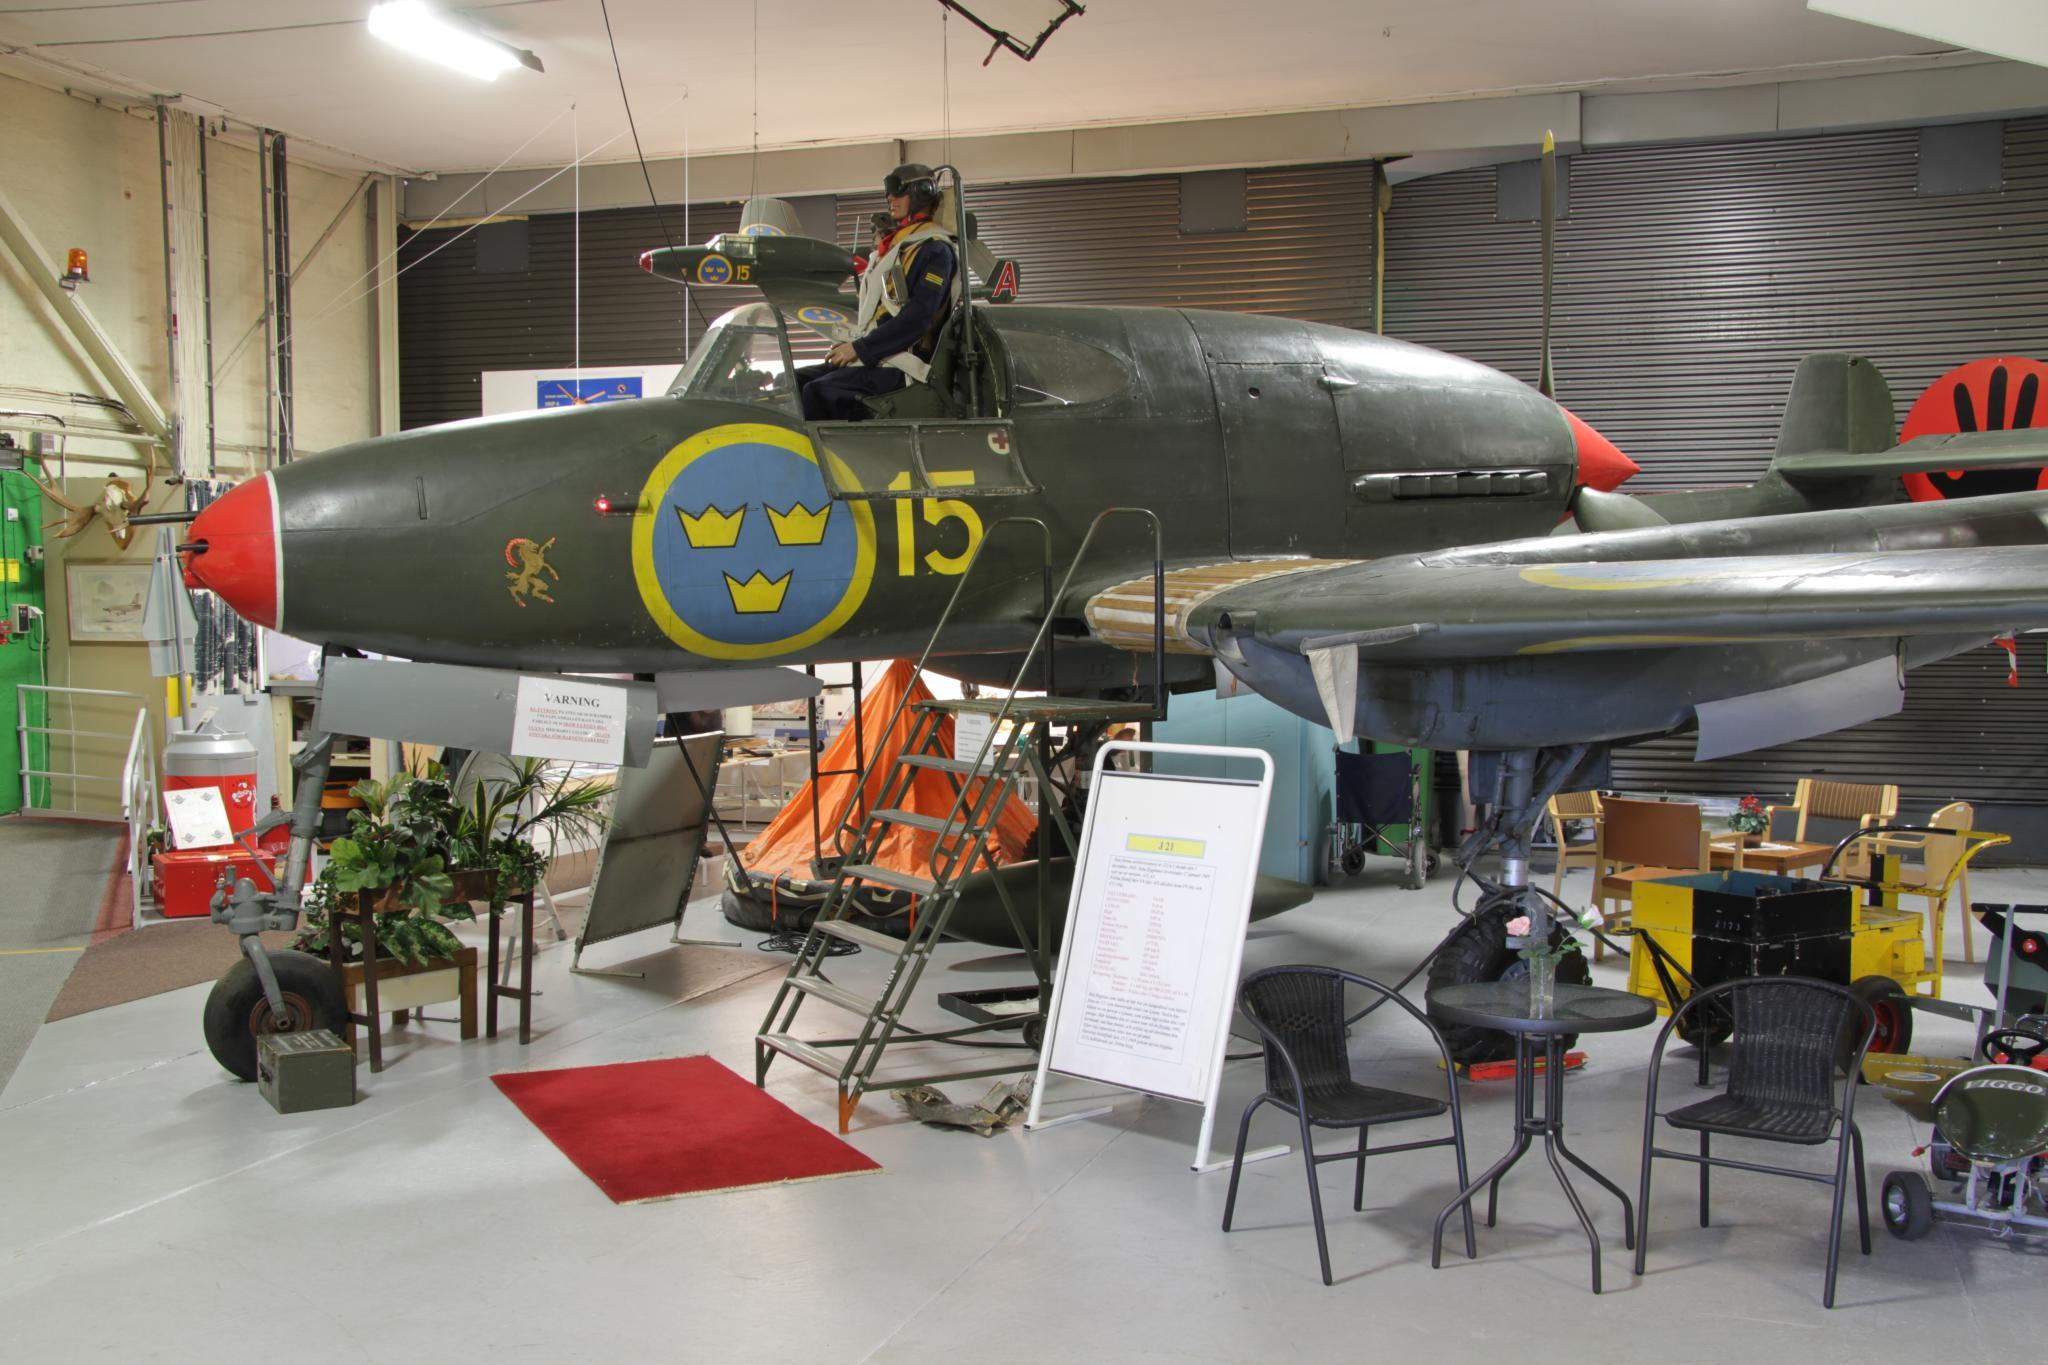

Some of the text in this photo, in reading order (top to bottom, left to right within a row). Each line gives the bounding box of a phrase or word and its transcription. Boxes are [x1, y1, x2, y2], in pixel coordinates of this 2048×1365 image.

[736, 265, 751, 281] 15
[992, 261, 1017, 297] A
[887, 470, 984, 577] 15
[544, 693, 601, 707] VARNING
